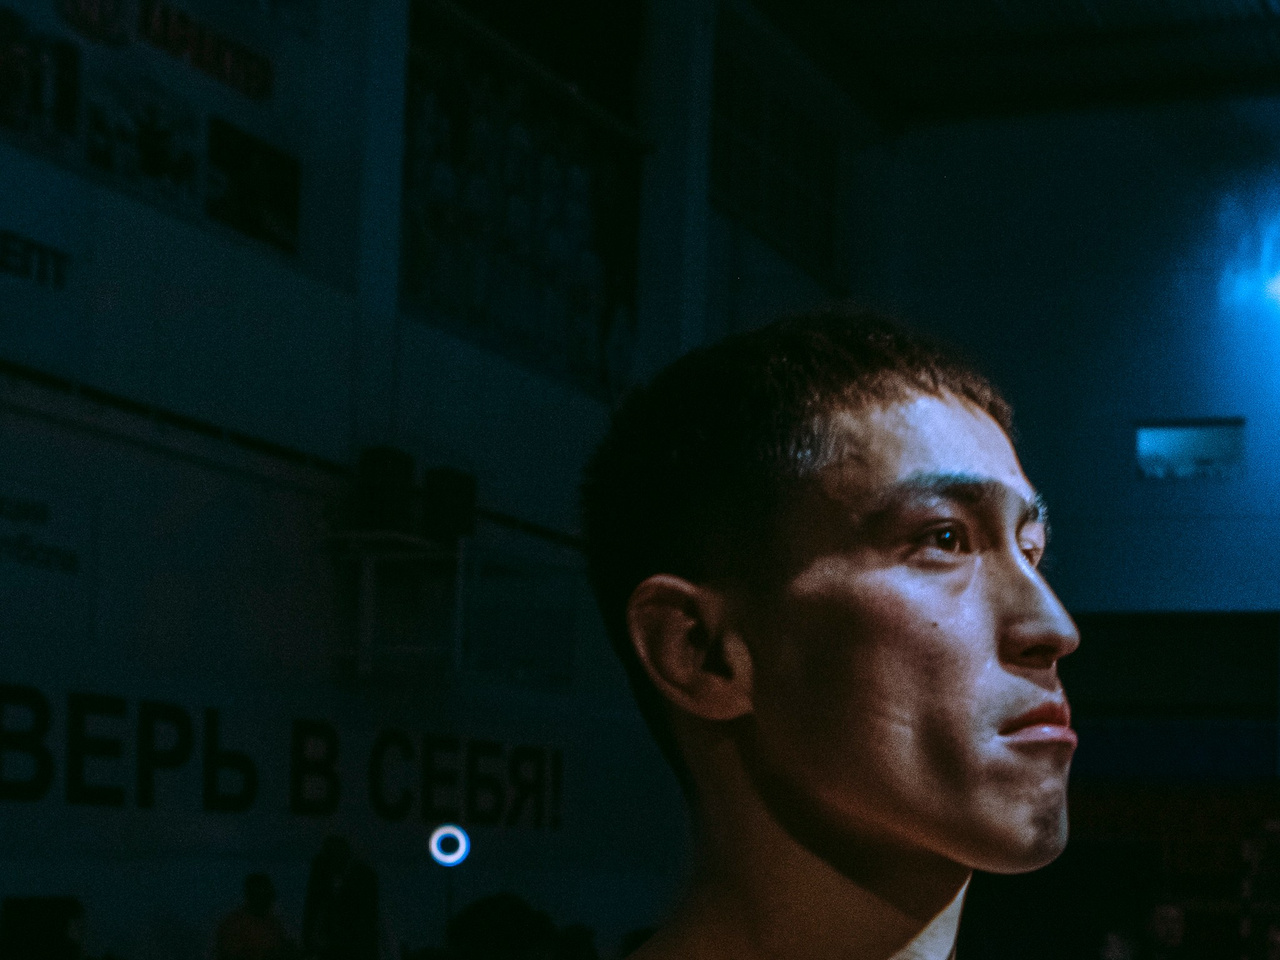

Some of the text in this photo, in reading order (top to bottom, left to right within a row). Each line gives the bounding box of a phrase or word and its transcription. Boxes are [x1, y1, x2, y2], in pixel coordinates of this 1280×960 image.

[0, 684, 563, 831] ВЕРЬ В СЕБЯ!
